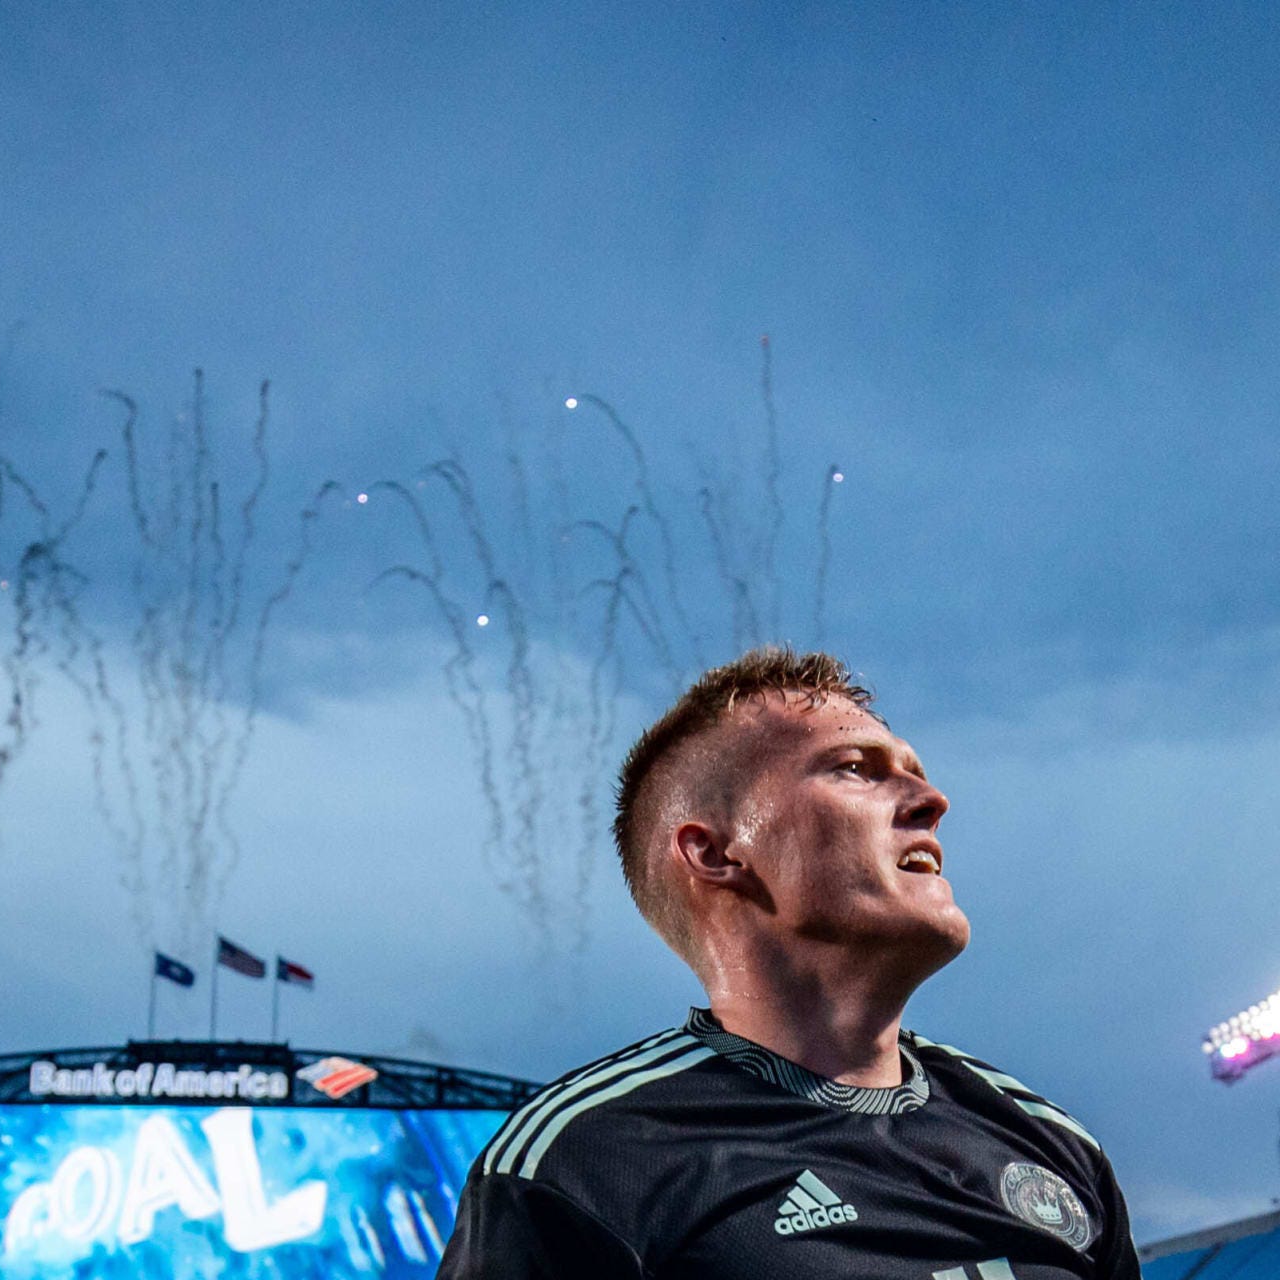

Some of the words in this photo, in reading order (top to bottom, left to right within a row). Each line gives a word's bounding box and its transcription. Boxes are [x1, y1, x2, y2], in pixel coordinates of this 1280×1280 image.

[30, 1061, 117, 1096] Bank
[115, 1063, 154, 1096] of
[152, 1063, 289, 1098] America
[774, 1203, 859, 1236] adidas
